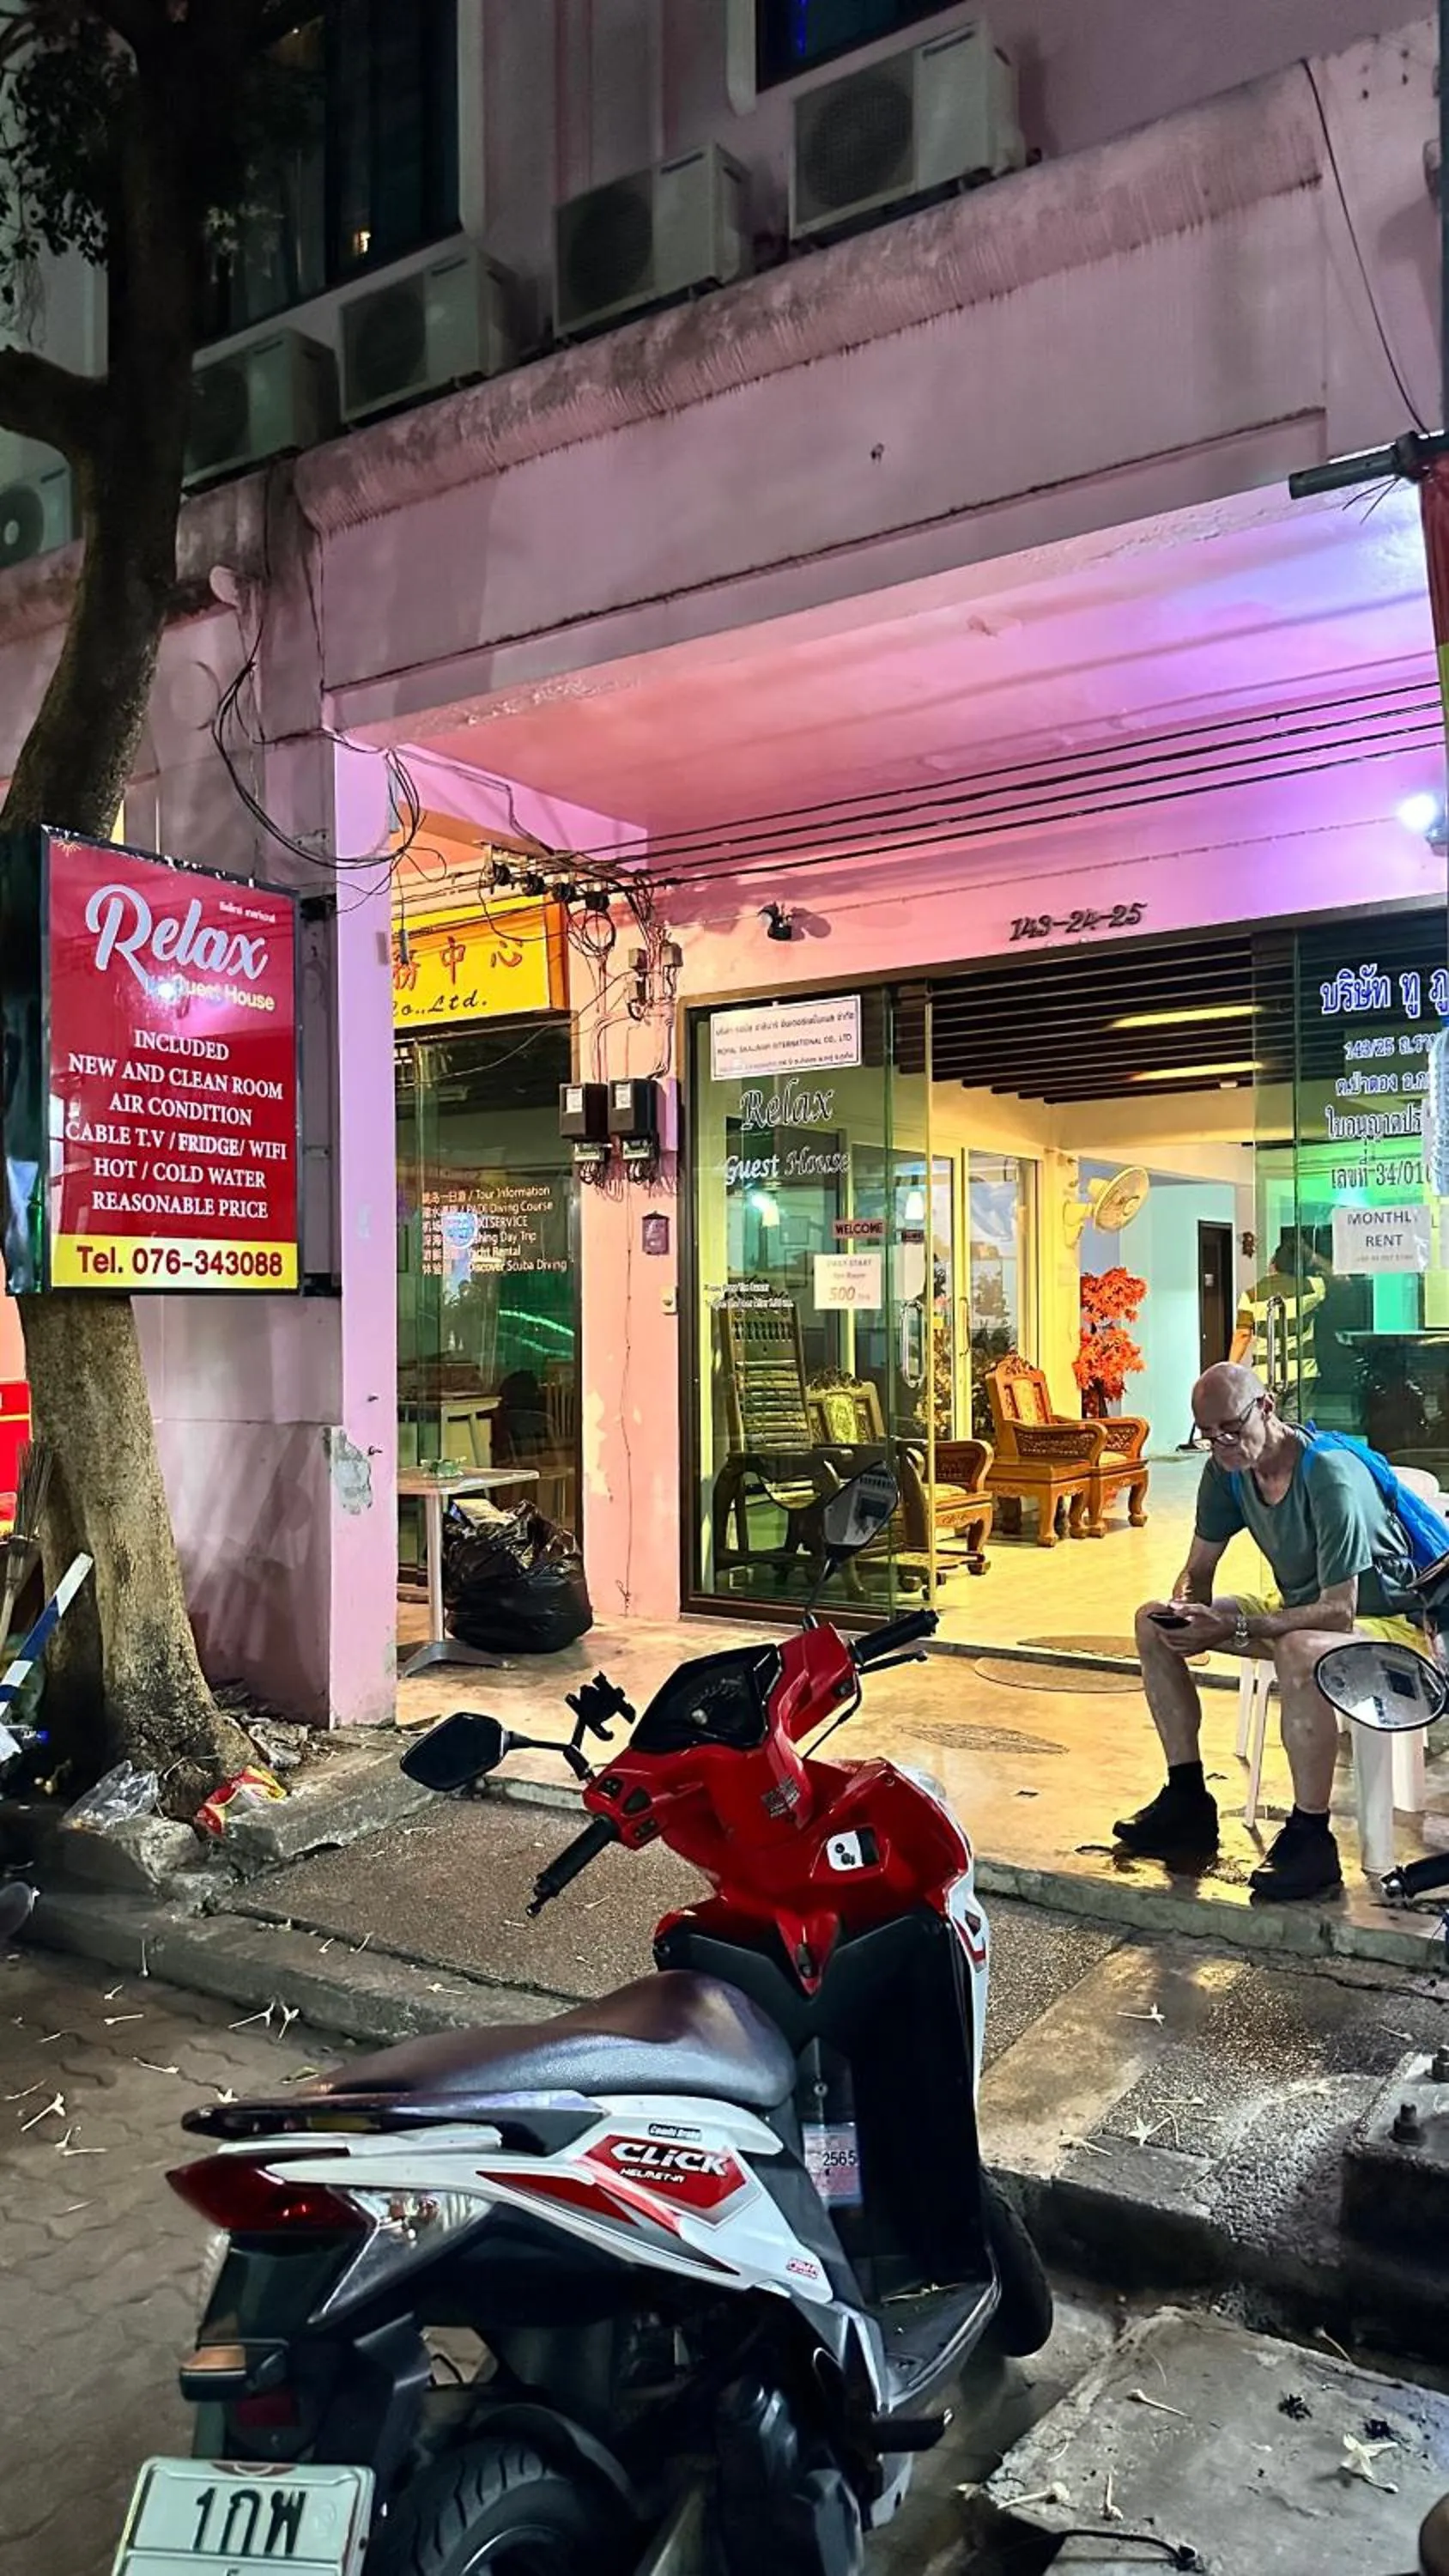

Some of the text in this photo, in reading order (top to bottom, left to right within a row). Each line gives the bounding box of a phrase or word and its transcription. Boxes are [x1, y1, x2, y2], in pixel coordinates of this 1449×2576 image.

[1009, 902, 1148, 941] 143-24-25
[86, 884, 269, 993] Relax
[225, 983, 275, 1012] House
[1320, 963, 1391, 1015] บริษัท
[135, 1030, 229, 1060] INCLUDED
[69, 1053, 284, 1100] NEW AND CLEAN ROOM
[110, 1092, 252, 1127] AIR CONDITION
[739, 1078, 835, 1131] Relax
[66, 1121, 131, 1143] CABLE
[136, 1128, 165, 1147] T.V
[249, 1139, 288, 1160] WIFI
[93, 1157, 137, 1179] HOT
[153, 1163, 203, 1183] COLD
[208, 1168, 267, 1189] WATER
[724, 1145, 852, 1185] Guest House
[92, 1191, 269, 1219] REASONABLE PRICE
[476, 1189, 495, 1200] Tour
[496, 1187, 551, 1199] Information
[520, 1200, 555, 1212] Course
[834, 1222, 883, 1236] WELCOME
[1366, 1234, 1403, 1248] RENT
[76, 1245, 282, 1277] Tel. 076-343088
[506, 1260, 534, 1272] Scuba
[823, 2149, 857, 2166] 2565
